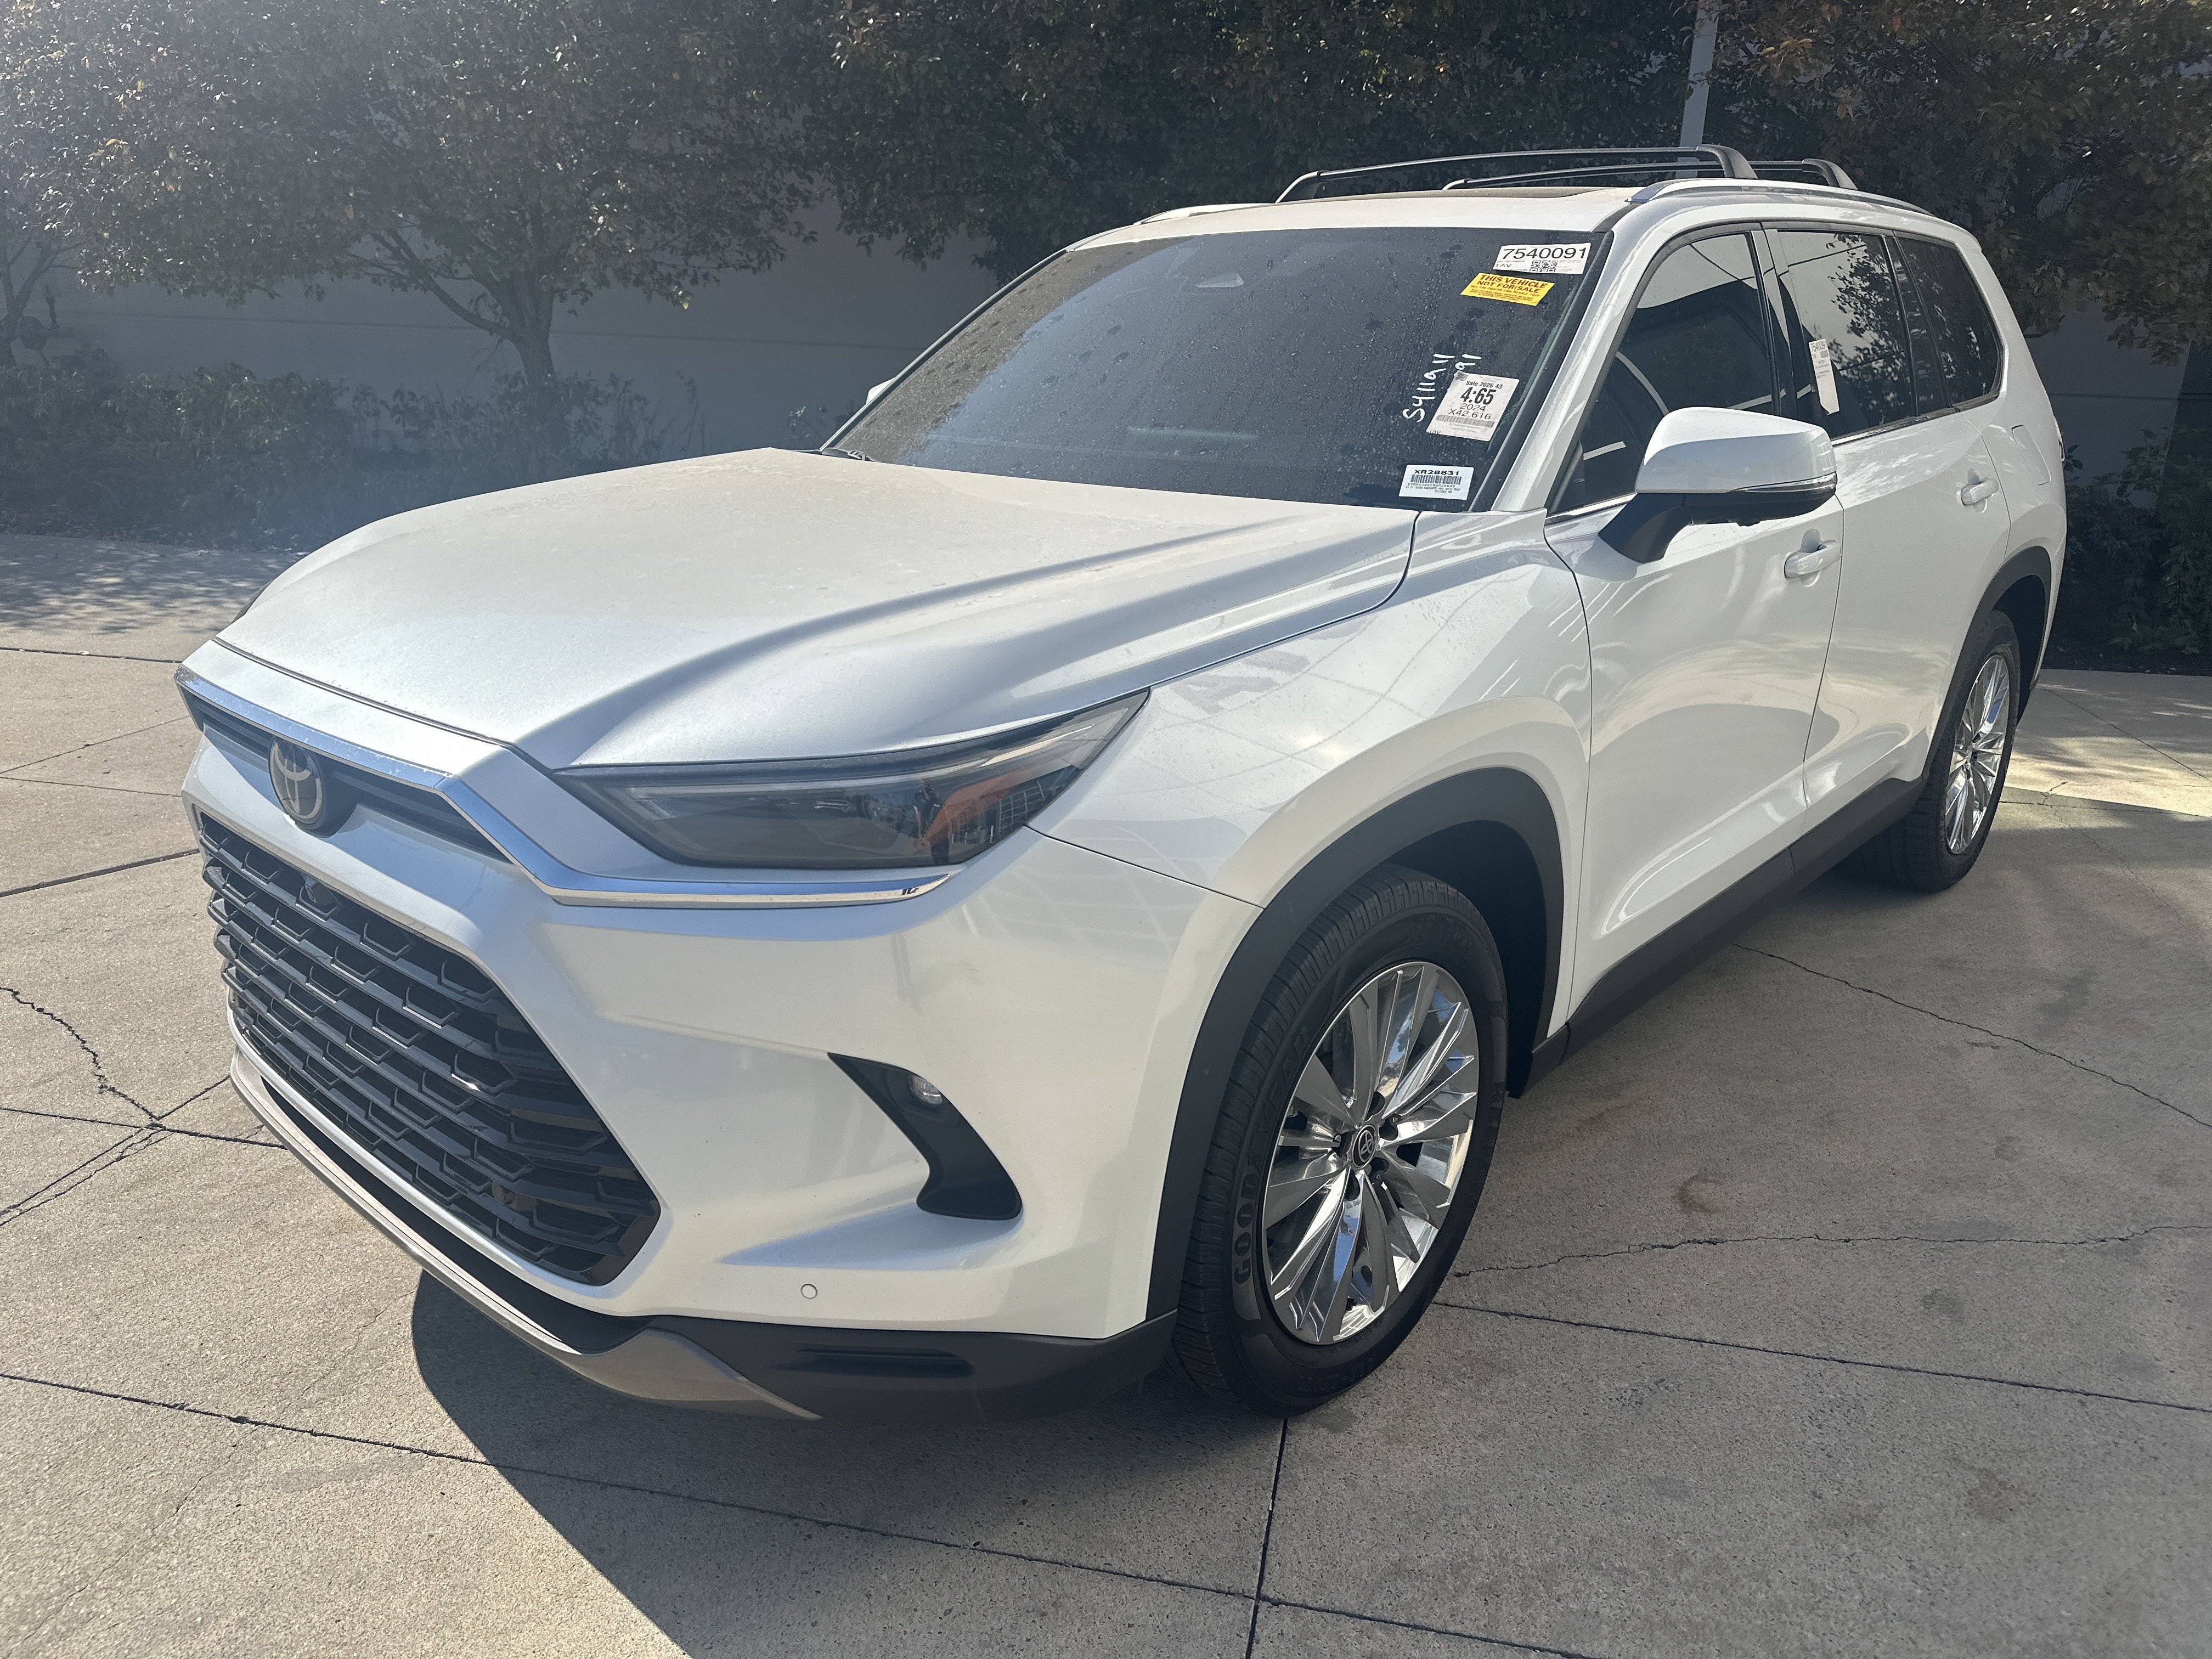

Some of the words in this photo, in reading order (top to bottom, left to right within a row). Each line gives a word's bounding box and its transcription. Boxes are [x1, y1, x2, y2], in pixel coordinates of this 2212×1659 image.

[1502, 247, 1587, 259] 7540091
[1480, 274, 1504, 283] THIS
[1505, 278, 1549, 289] VEHICLE
[1460, 387, 1497, 405] 4:65
[1459, 403, 1486, 411] 2024
